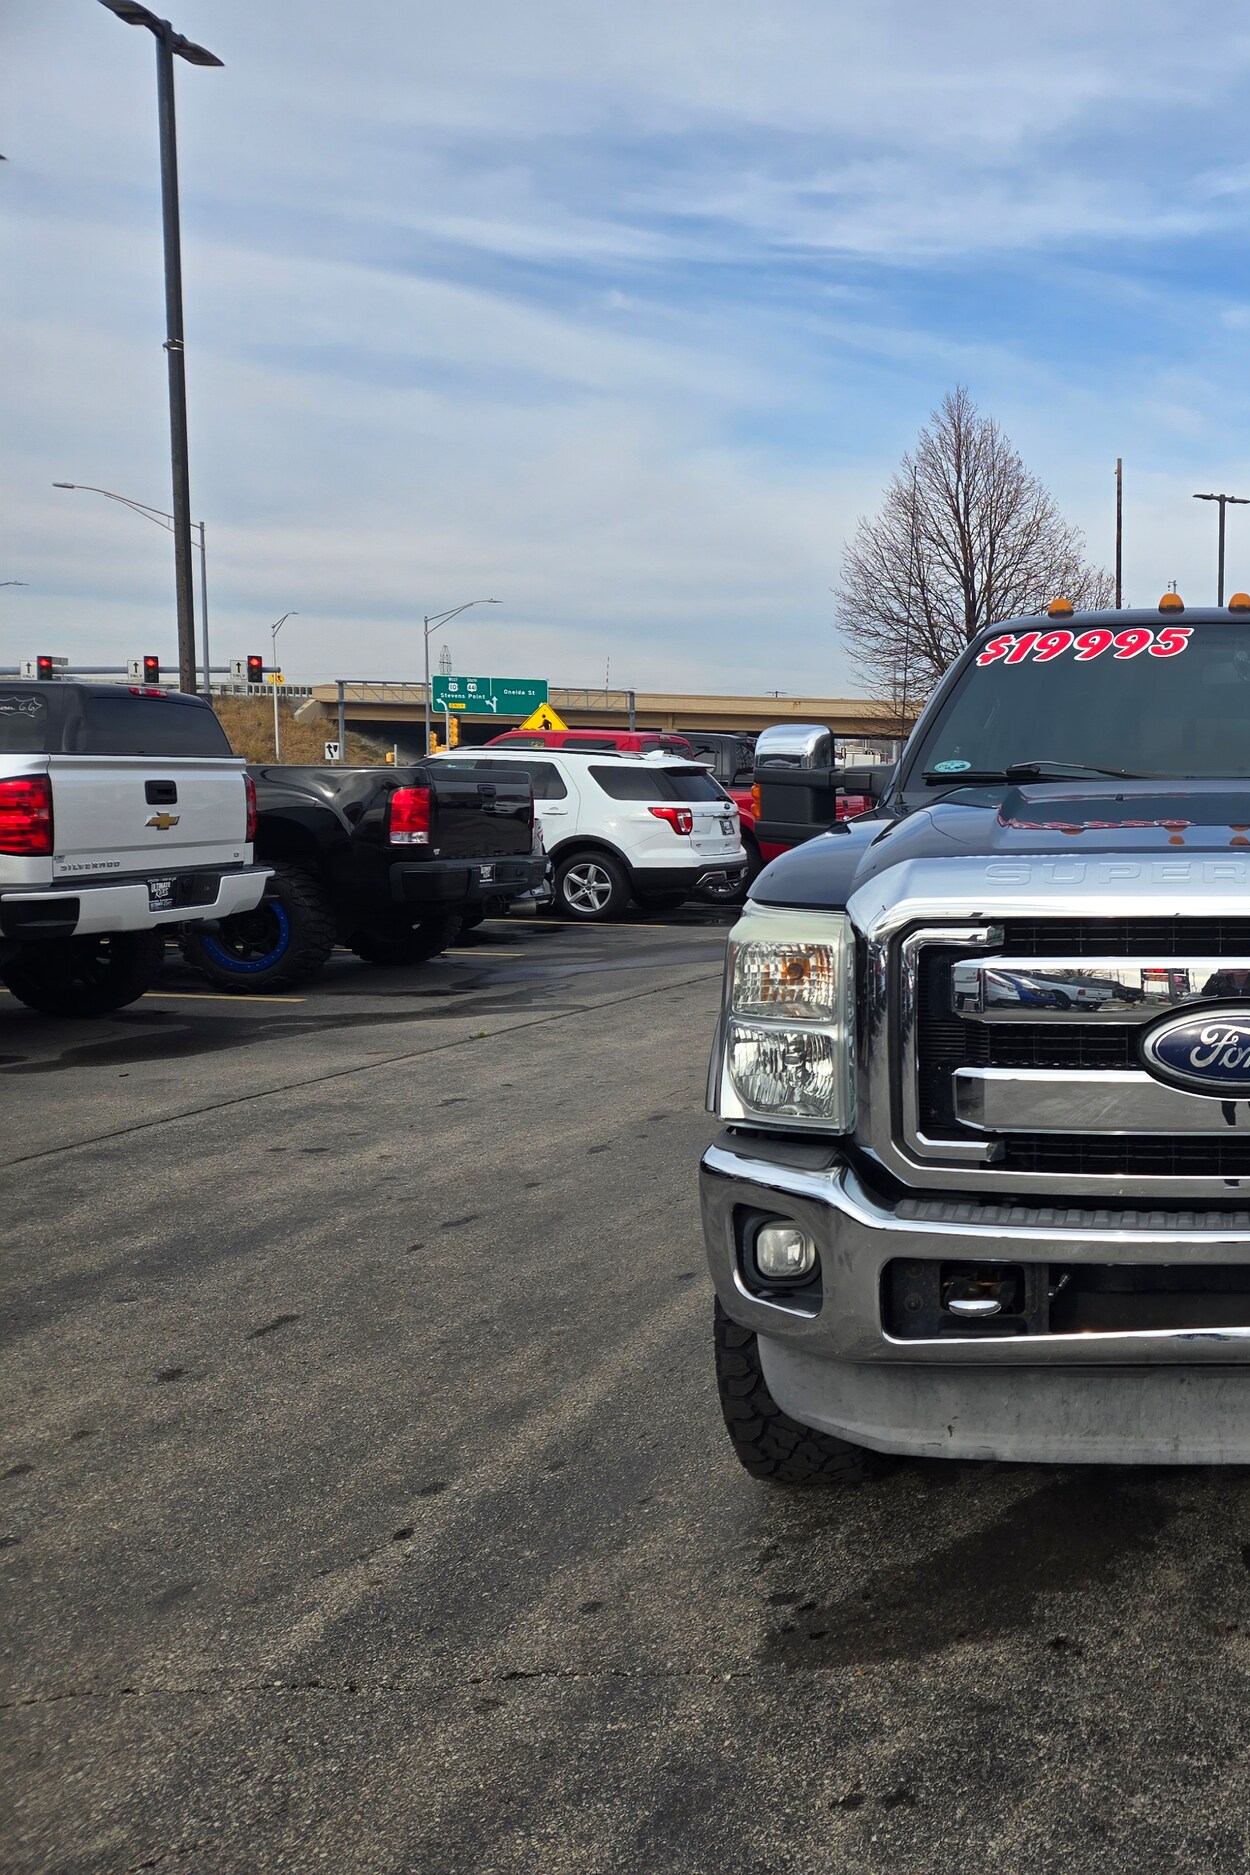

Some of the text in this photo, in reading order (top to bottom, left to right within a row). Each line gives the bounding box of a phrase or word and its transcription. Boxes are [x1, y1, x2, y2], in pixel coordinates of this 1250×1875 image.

[976, 627, 1195, 666] $19995
[503, 688, 526, 696] Oneida
[60, 861, 120, 871] SILVERADO
[984, 862, 1248, 886] SUPER
